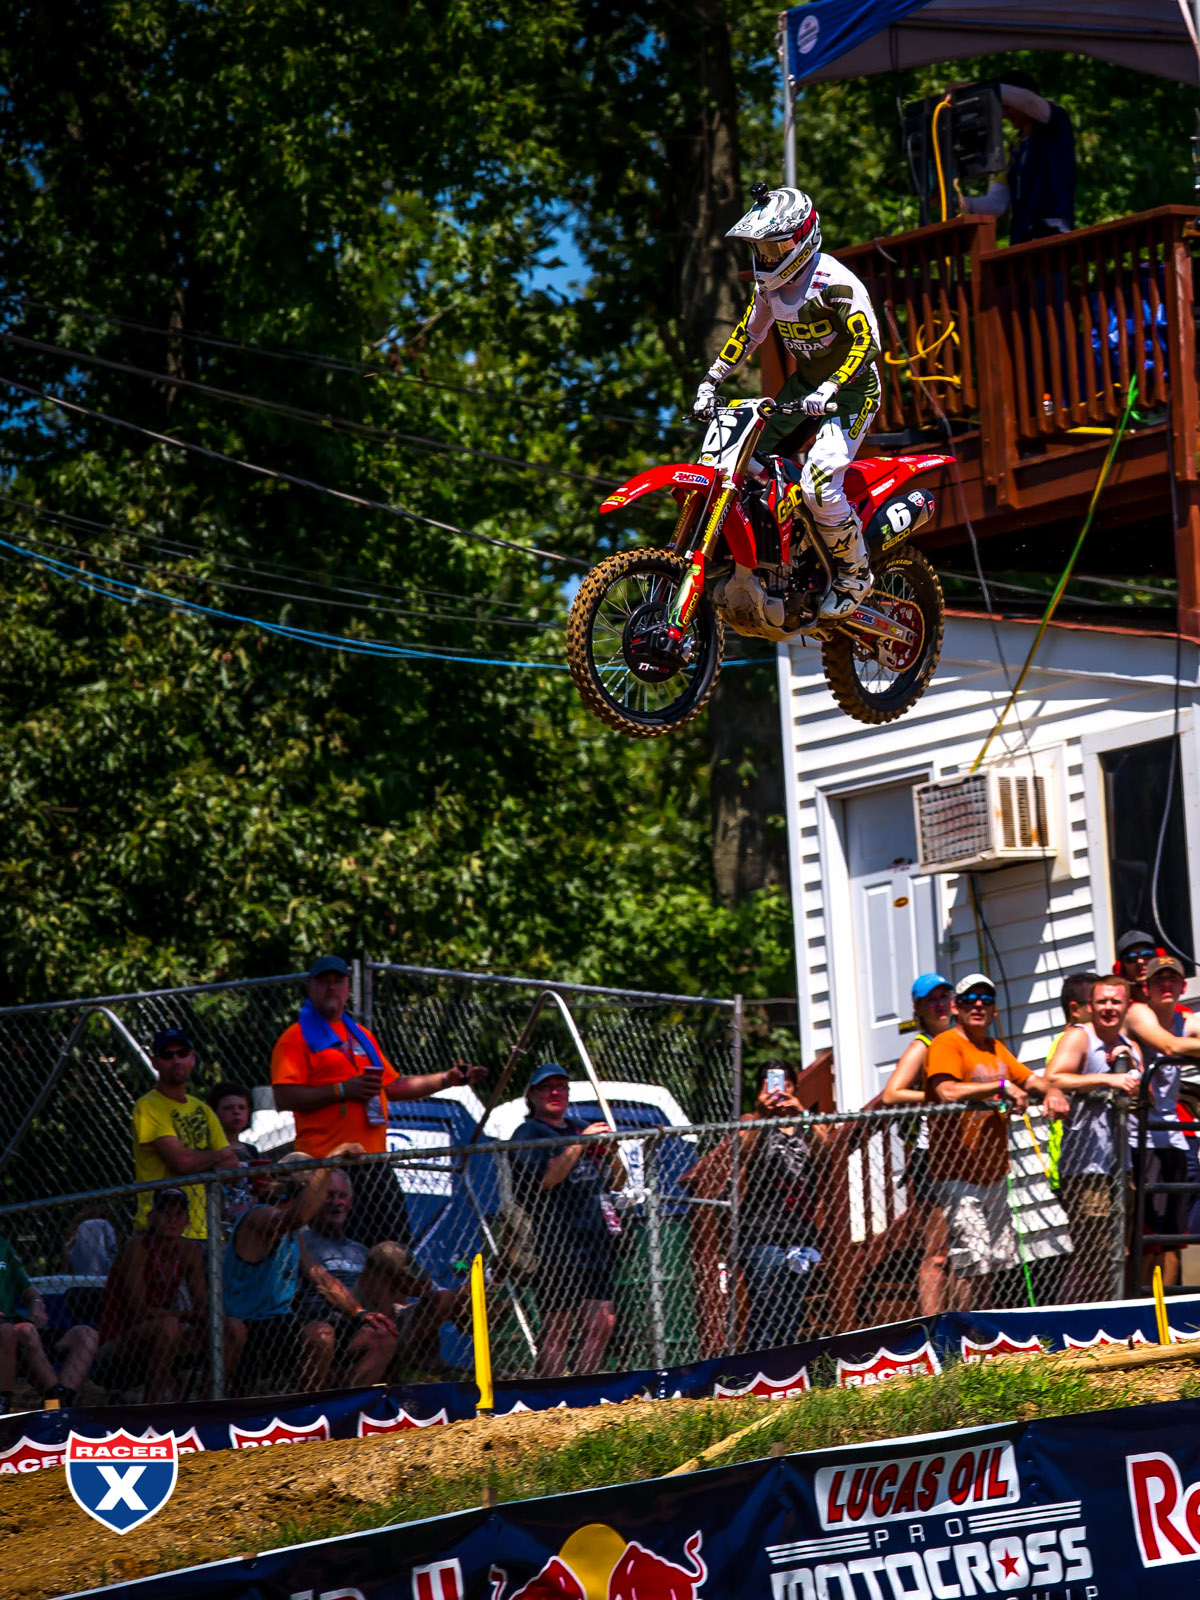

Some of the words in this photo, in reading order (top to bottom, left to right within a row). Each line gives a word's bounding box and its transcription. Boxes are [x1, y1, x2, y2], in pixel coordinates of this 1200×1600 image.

[781, 248, 811, 279] GEICO
[776, 318, 833, 340] EICO
[785, 342, 826, 352] ONDA
[701, 415, 738, 452] 6
[849, 397, 874, 439] GEICO
[675, 472, 709, 485] AMSOIL
[777, 483, 803, 525] GEIC
[886, 503, 911, 533] 6
[882, 527, 910, 551] GEICO
[683, 591, 698, 625] GEICO
[826, 1456, 945, 1523] LUCAS
[948, 1446, 1009, 1506] OIL
[874, 1517, 964, 1549] PRO
[770, 1526, 1094, 1600] MOTOCROSS
